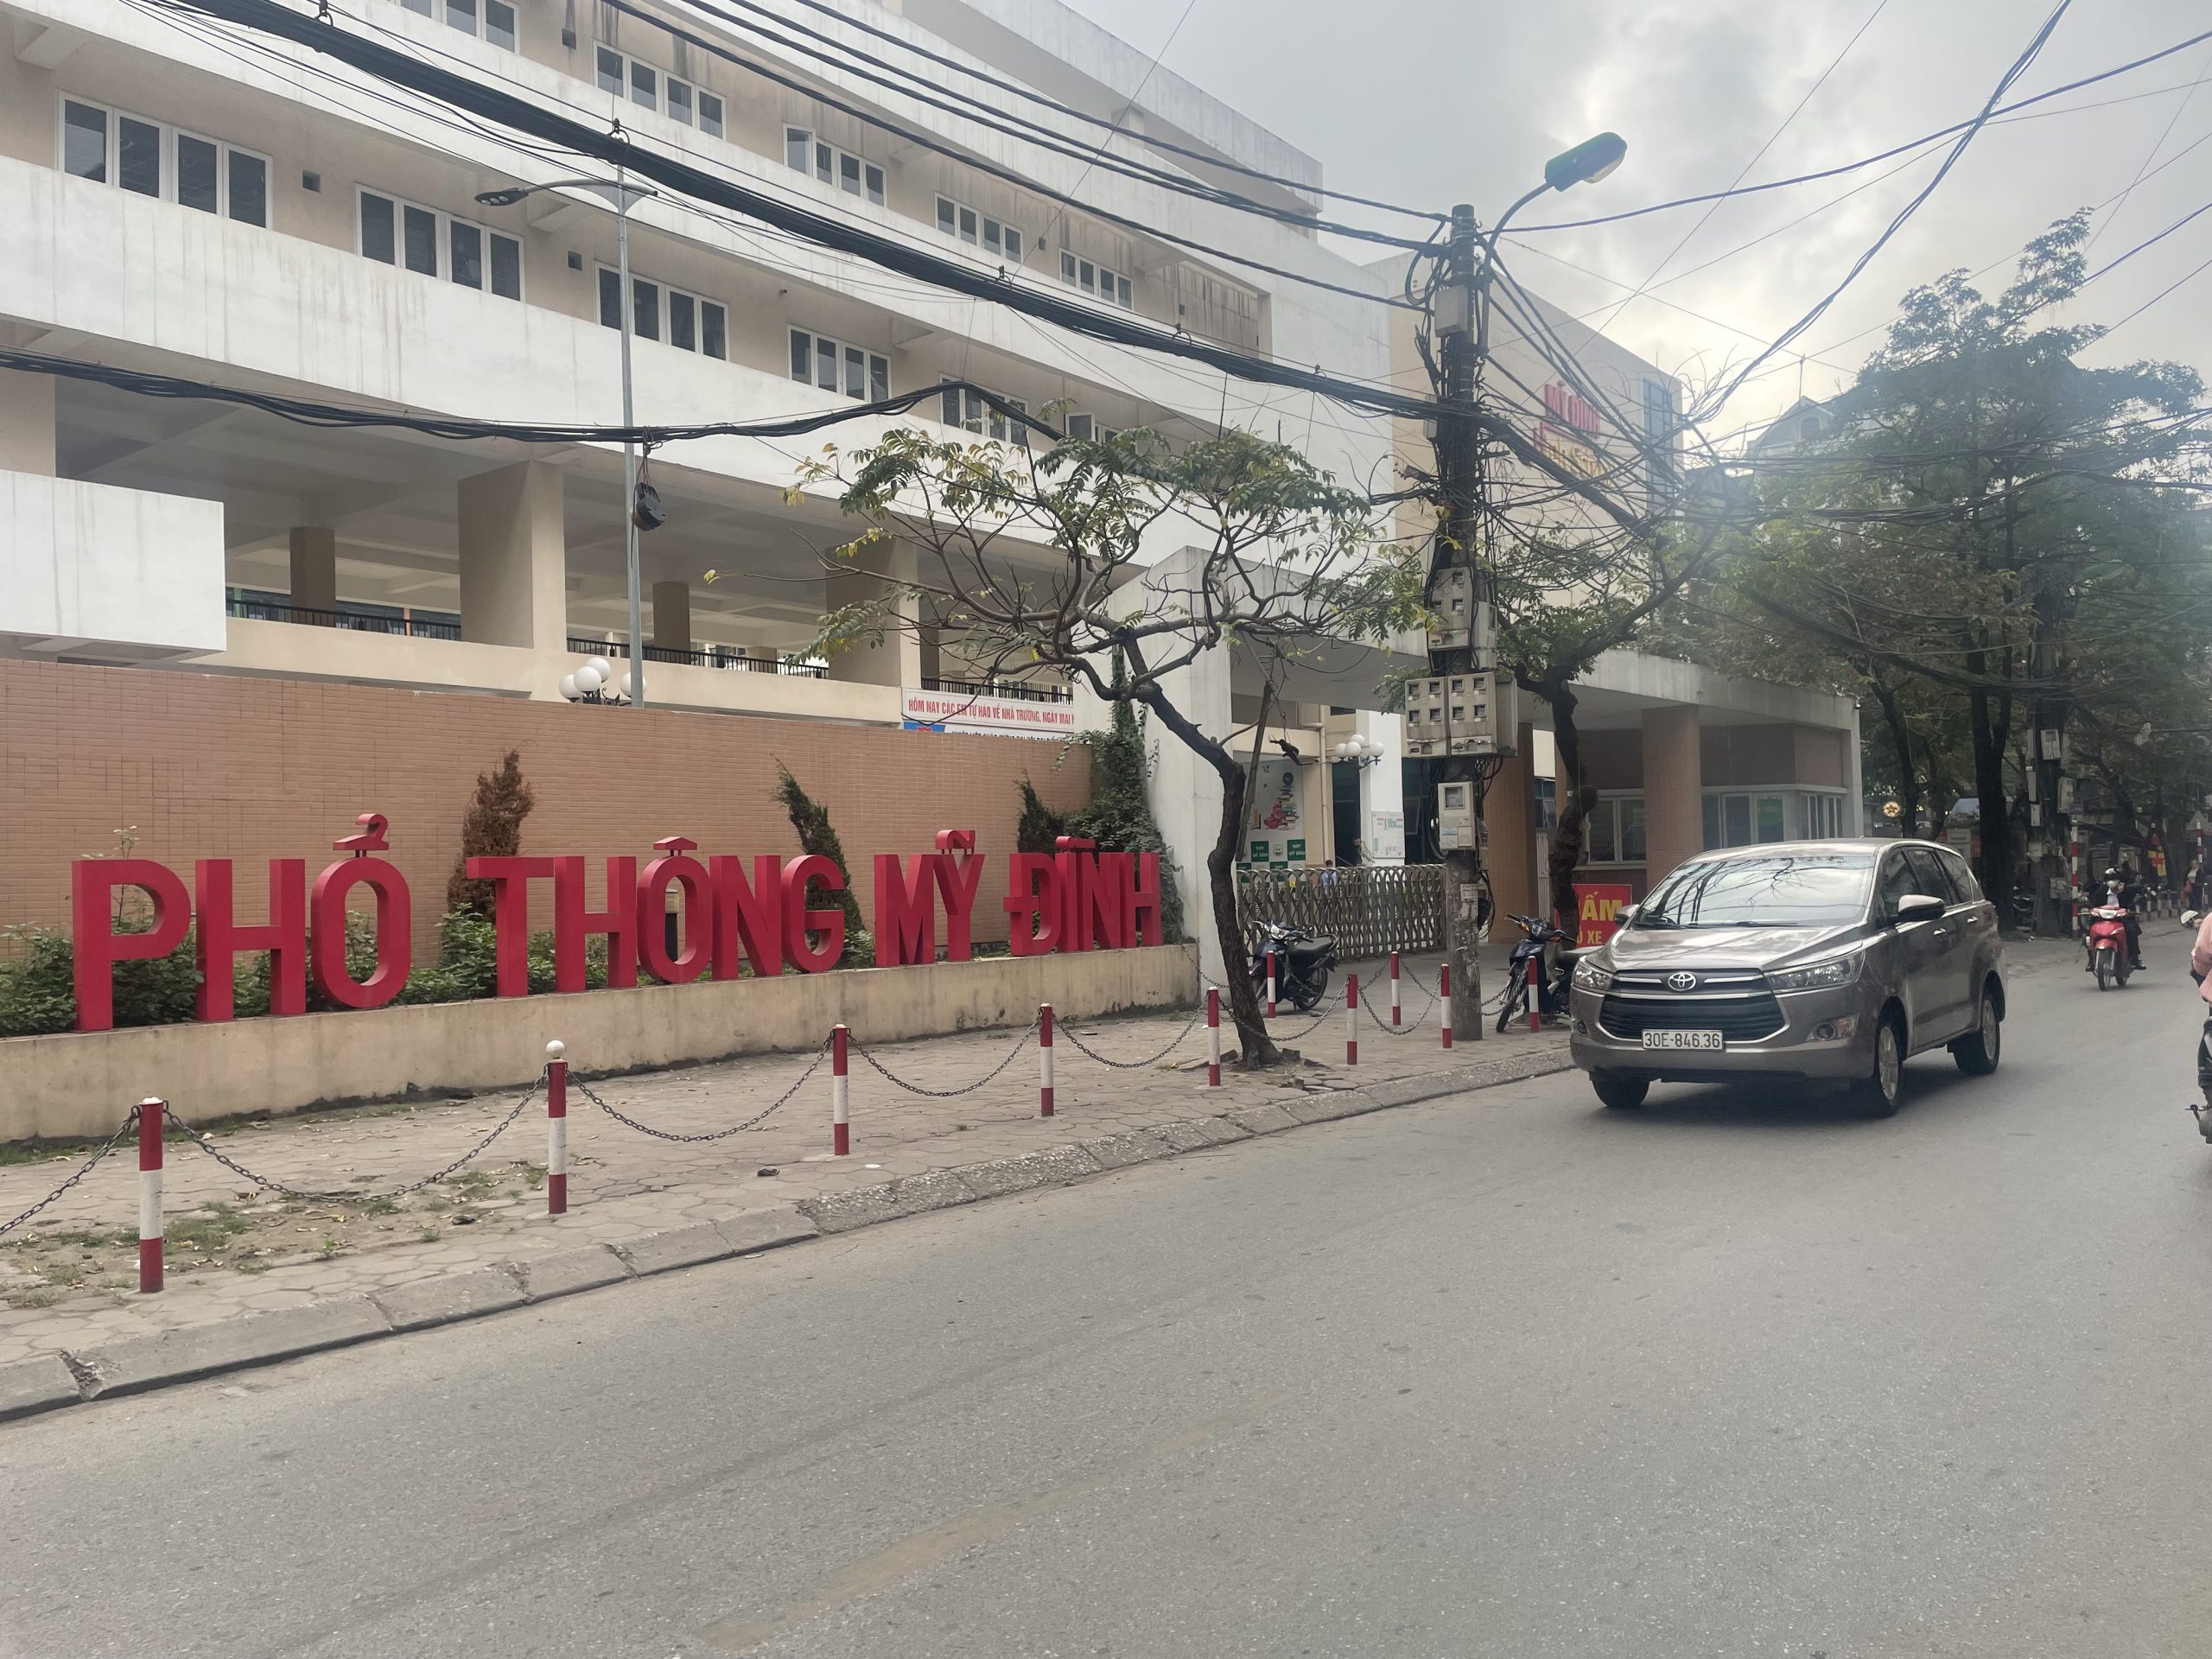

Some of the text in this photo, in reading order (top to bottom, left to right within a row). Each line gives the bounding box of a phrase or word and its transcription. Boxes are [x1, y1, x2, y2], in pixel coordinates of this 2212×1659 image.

[908, 696, 925, 712] HÔM
[926, 700, 940, 714] NAY
[942, 700, 956, 715] CÁC
[957, 703, 967, 716] EM
[968, 703, 978, 719] TỰ
[978, 703, 990, 718] HÀO
[1002, 707, 1014, 720] NHÀ
[1042, 709, 1058, 724] NGÀY
[1059, 713, 1071, 725] MAI
[1581, 891, 1622, 921] ẤM
[72, 813, 1162, 1032] PHỔ THÔNG MỸ ĐÌNH
[1587, 931, 1602, 944] XE
[1644, 1033, 1720, 1048] 30E-846.36
